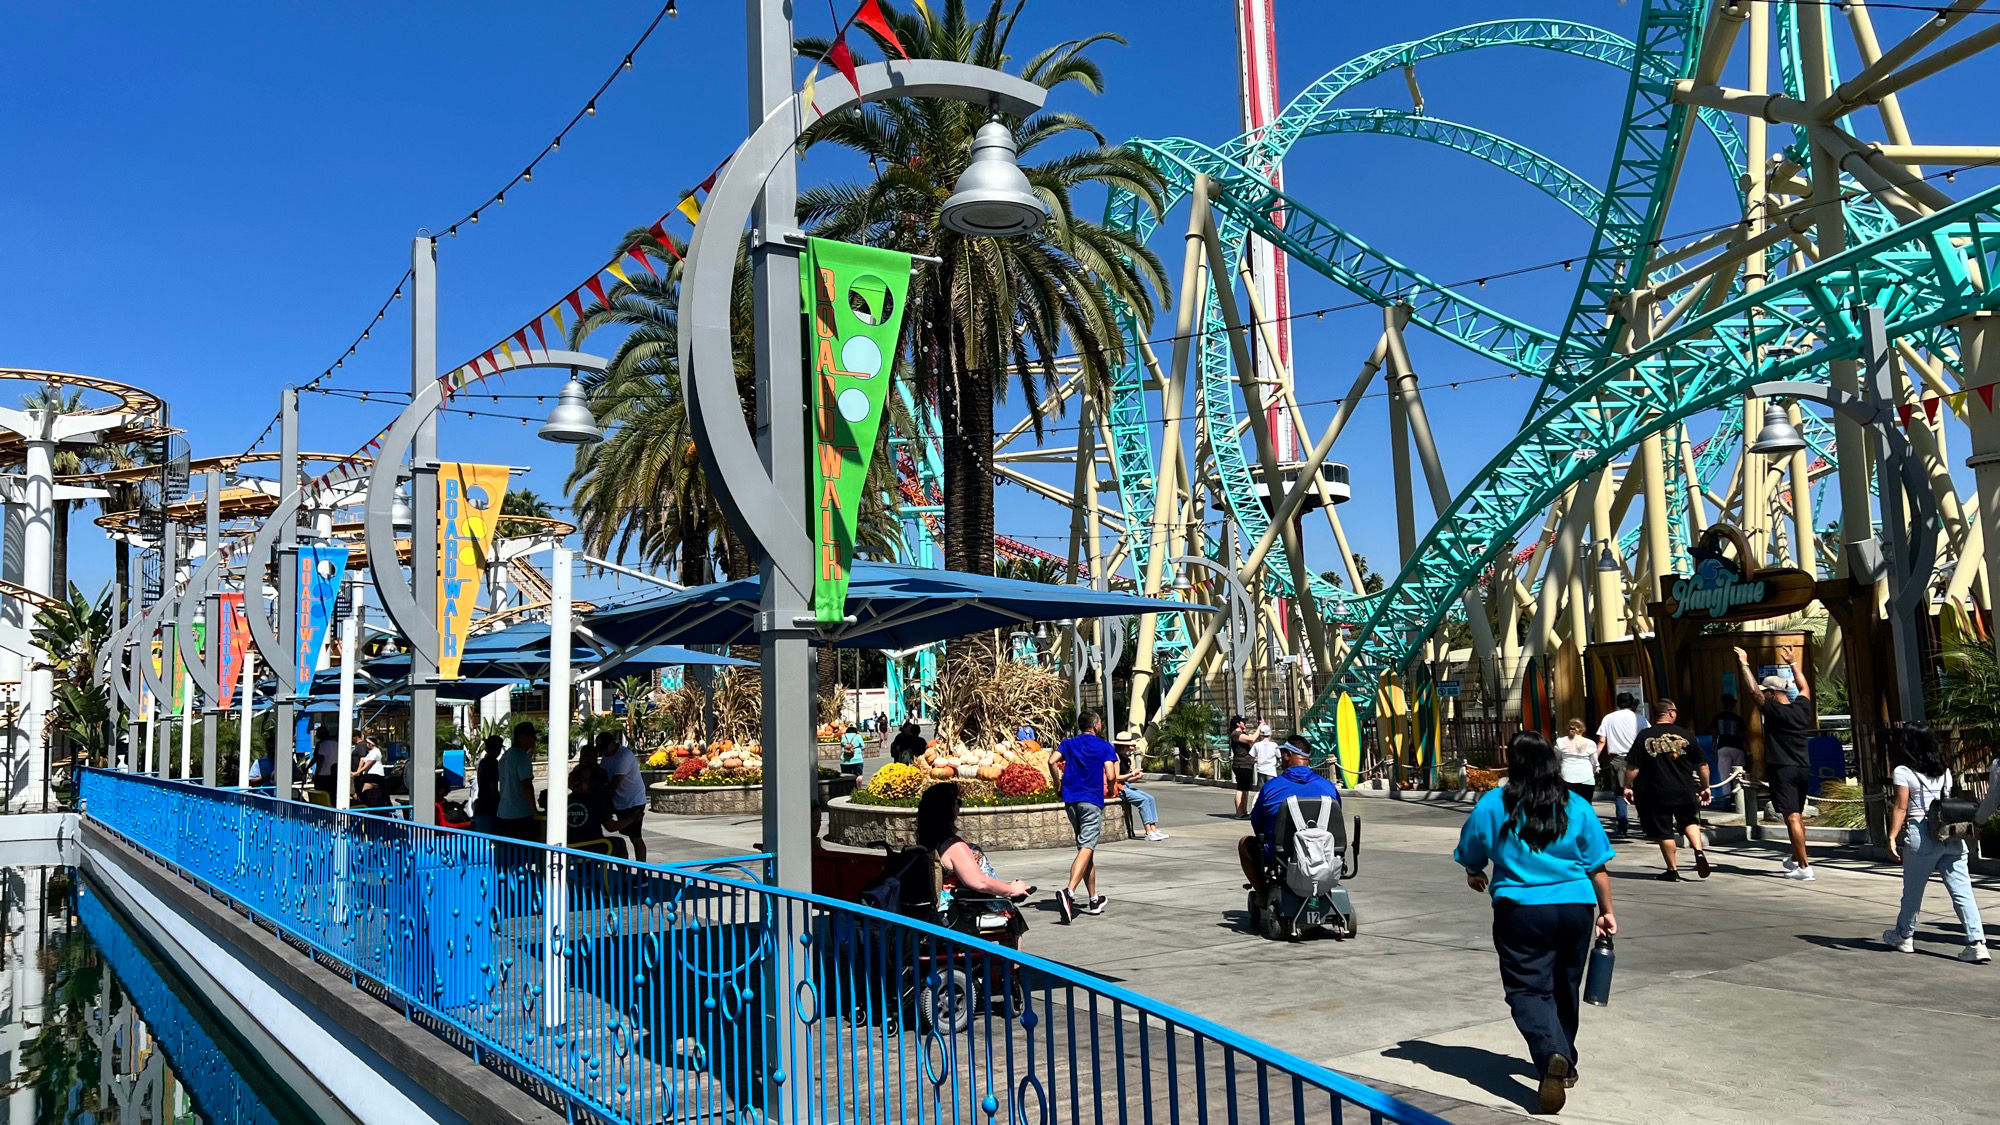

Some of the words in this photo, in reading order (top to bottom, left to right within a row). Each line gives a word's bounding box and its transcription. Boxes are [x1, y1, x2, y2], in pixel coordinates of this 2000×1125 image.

[815, 267, 871, 580] BOARDWALK
[299, 558, 328, 682] BOARDWALK
[443, 479, 480, 657] BOARDWALK
[1308, 912, 1319, 924] 12
